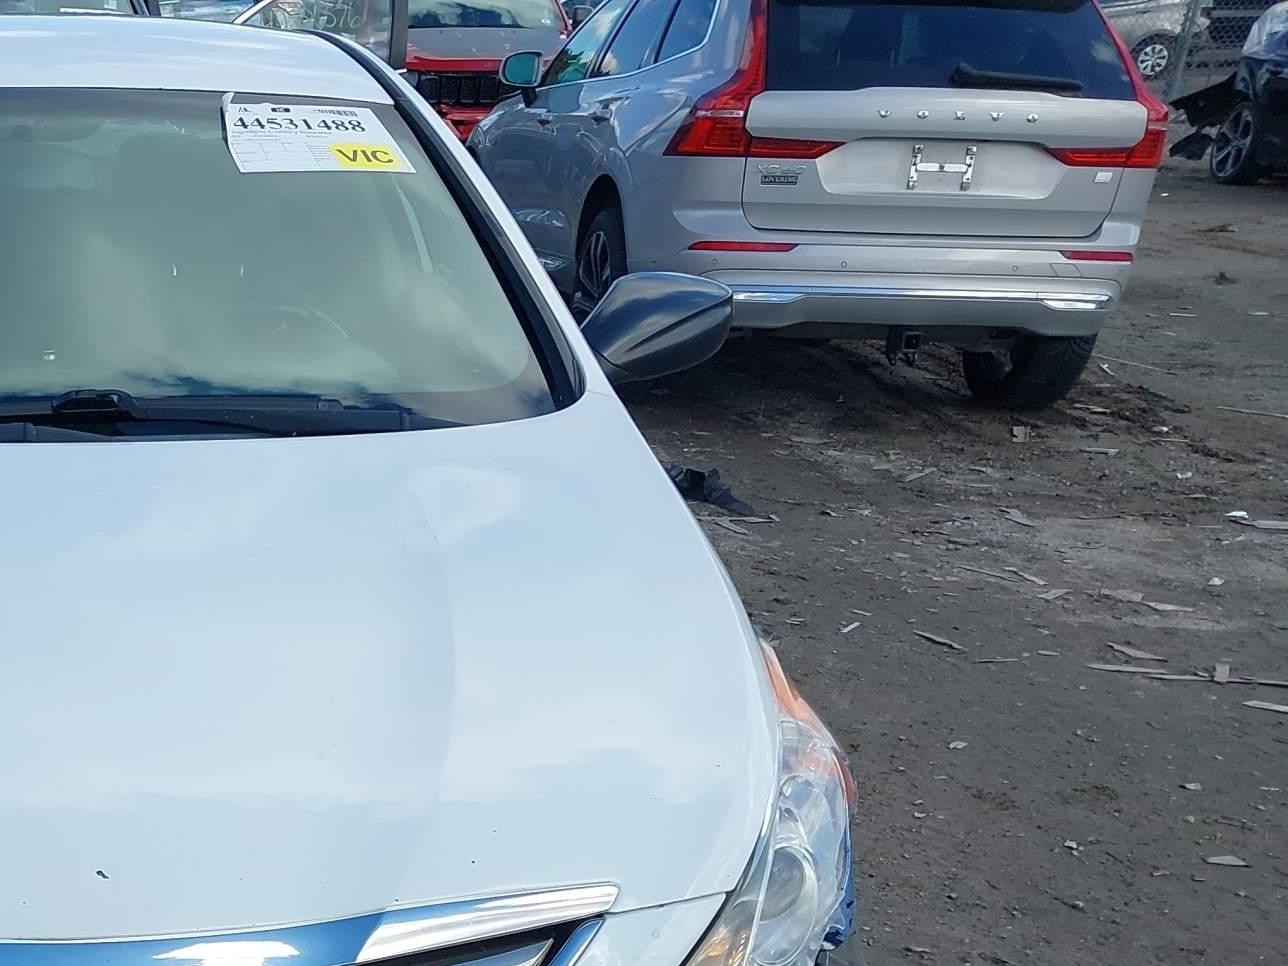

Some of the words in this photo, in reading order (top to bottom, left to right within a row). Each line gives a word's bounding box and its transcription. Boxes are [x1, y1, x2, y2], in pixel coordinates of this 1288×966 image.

[233, 116, 366, 132] 44531488
[877, 109, 1039, 123] VOLVO
[335, 148, 394, 164] VIC
